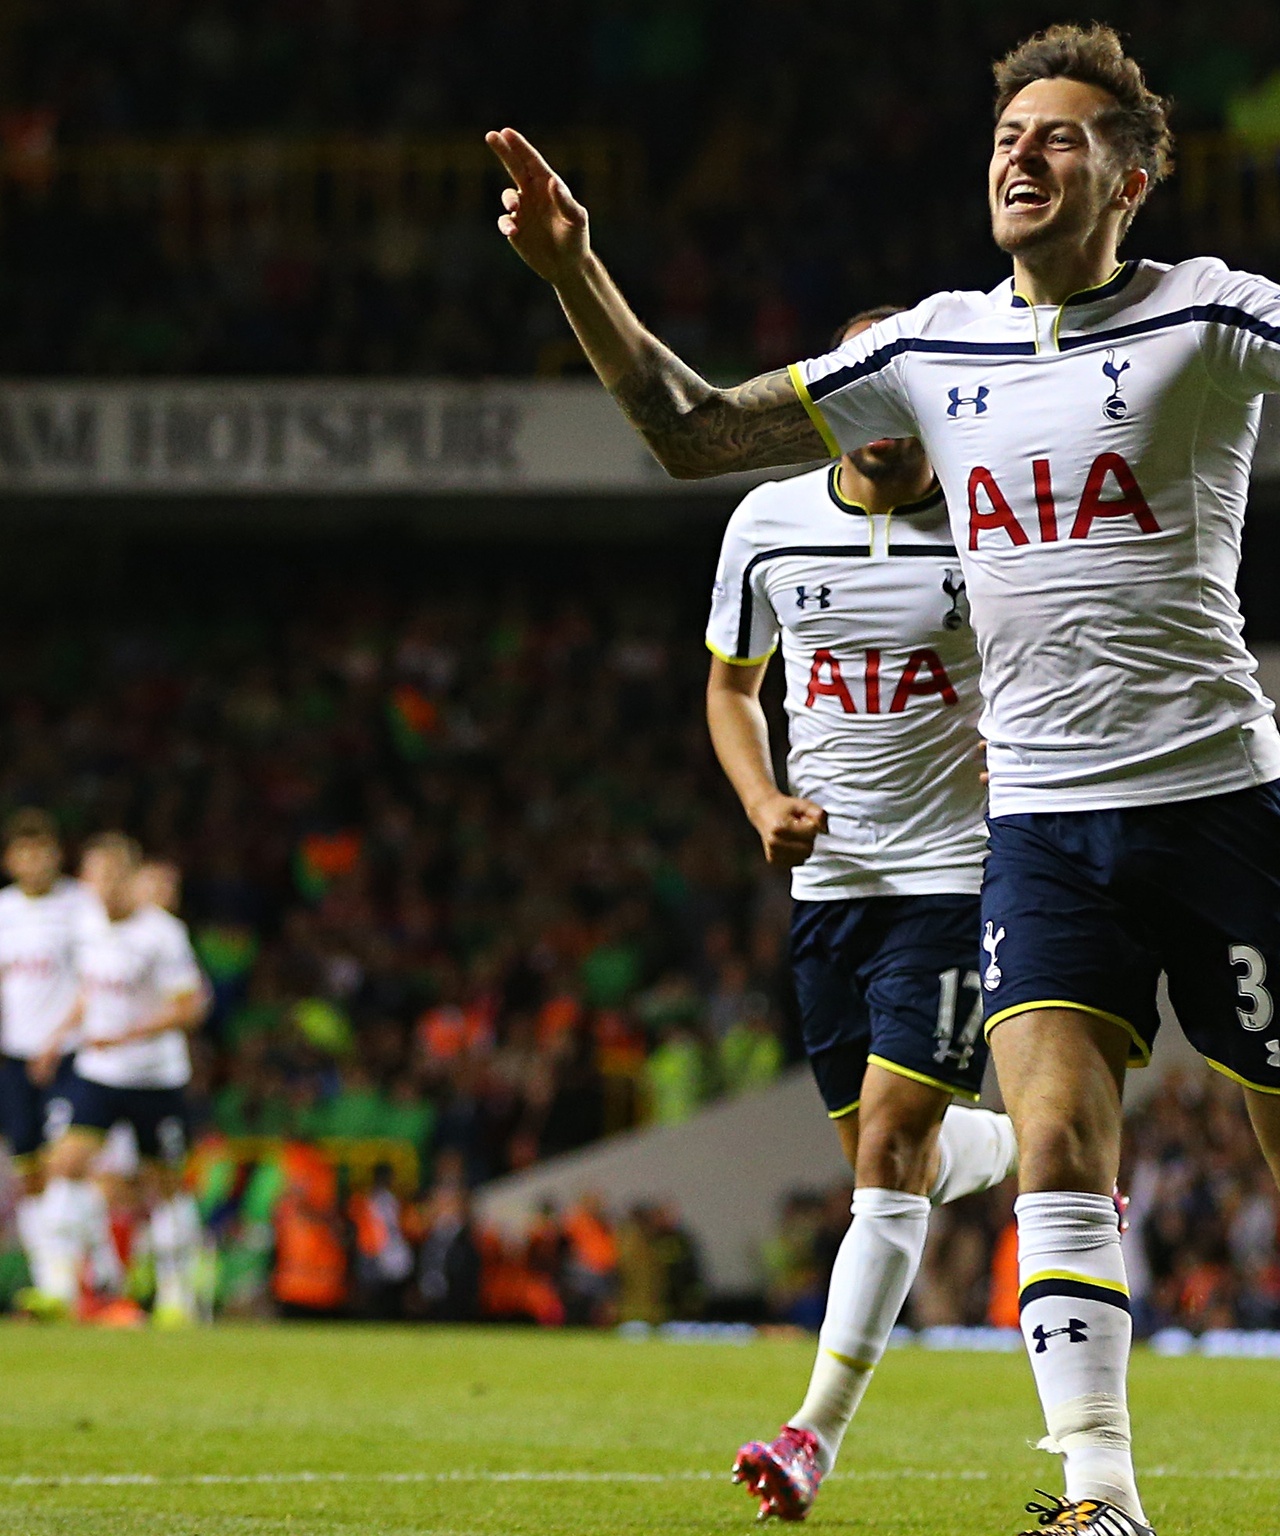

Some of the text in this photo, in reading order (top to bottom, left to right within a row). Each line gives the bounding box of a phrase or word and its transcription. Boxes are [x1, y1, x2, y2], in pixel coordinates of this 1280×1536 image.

[126, 398, 522, 470] HOTSPUR
[967, 451, 1163, 551] AIA
[804, 648, 960, 715] AIA
[932, 967, 985, 1046] 17
